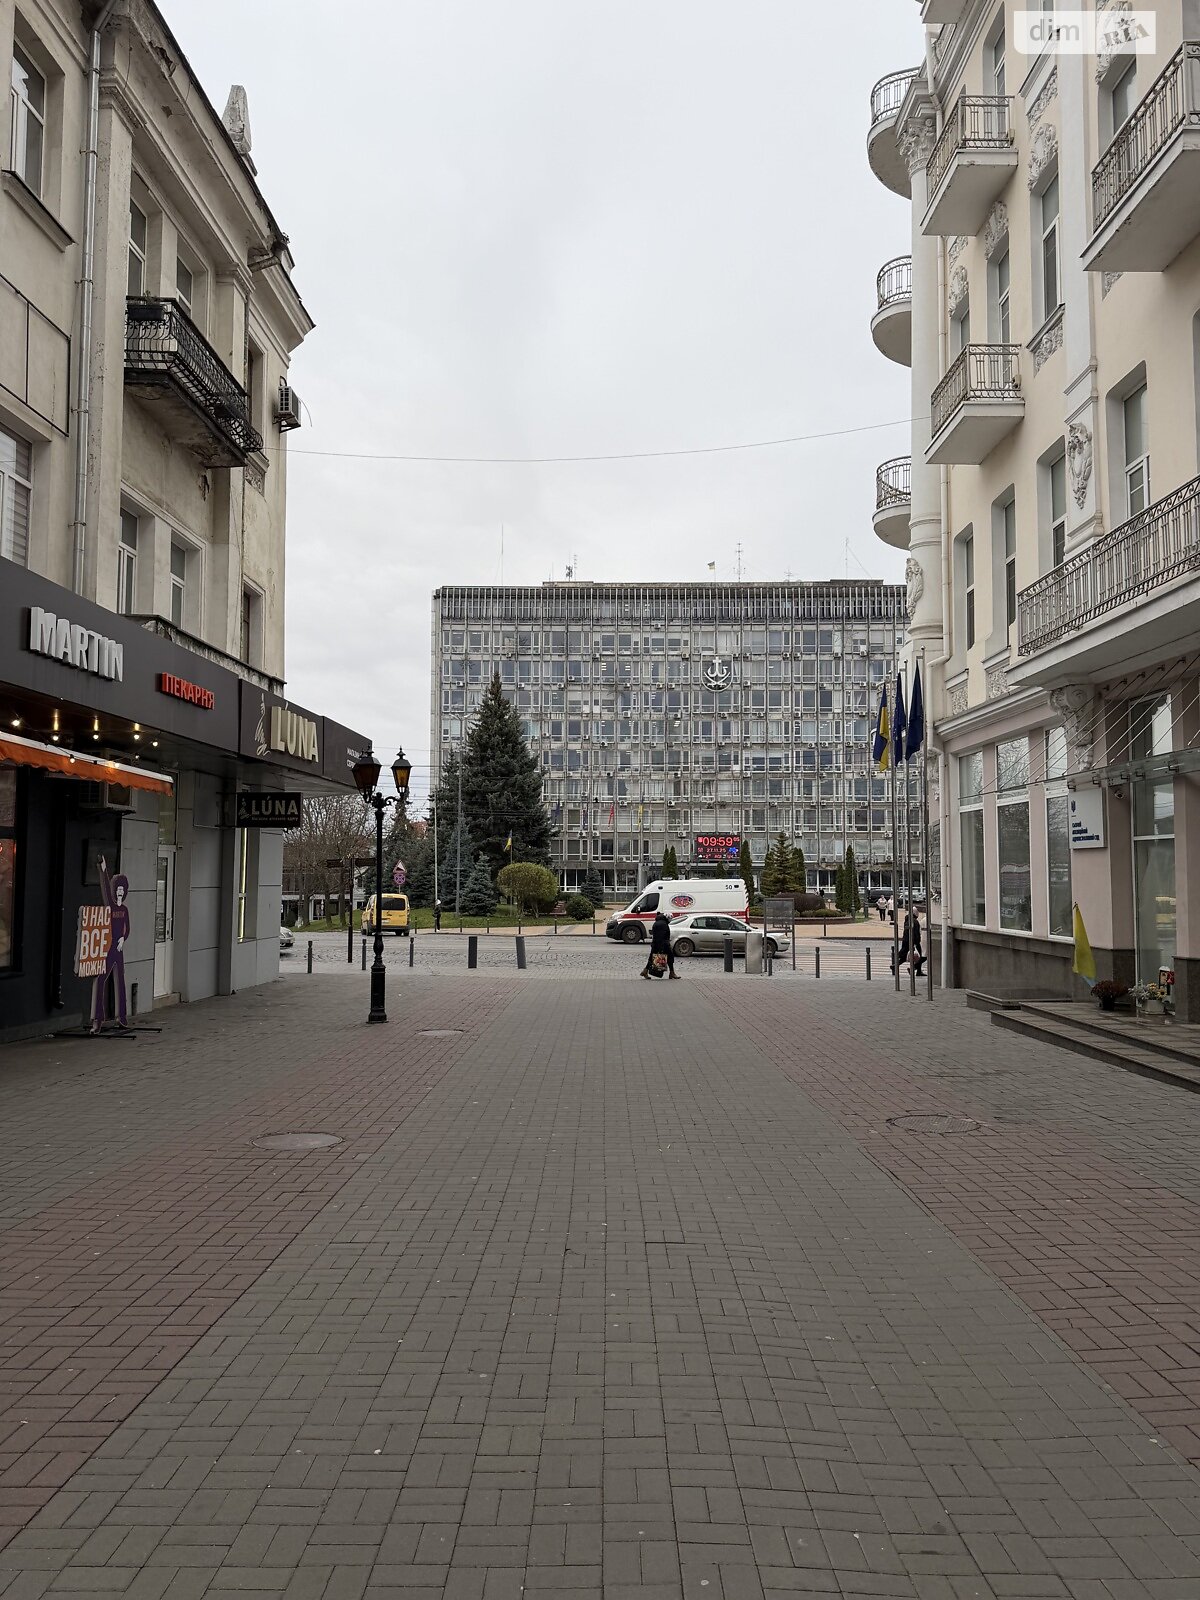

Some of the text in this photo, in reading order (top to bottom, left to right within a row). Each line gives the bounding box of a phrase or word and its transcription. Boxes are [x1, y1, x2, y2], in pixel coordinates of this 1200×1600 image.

[30, 606, 124, 682] MARTIN
[161, 671, 215, 710] ПЕКАРНЯ
[702, 836, 733, 847] 09:59
[82, 906, 111, 927] У НАС
[80, 928, 109, 960] ВСЕ
[78, 959, 107, 978] МОЖНА
